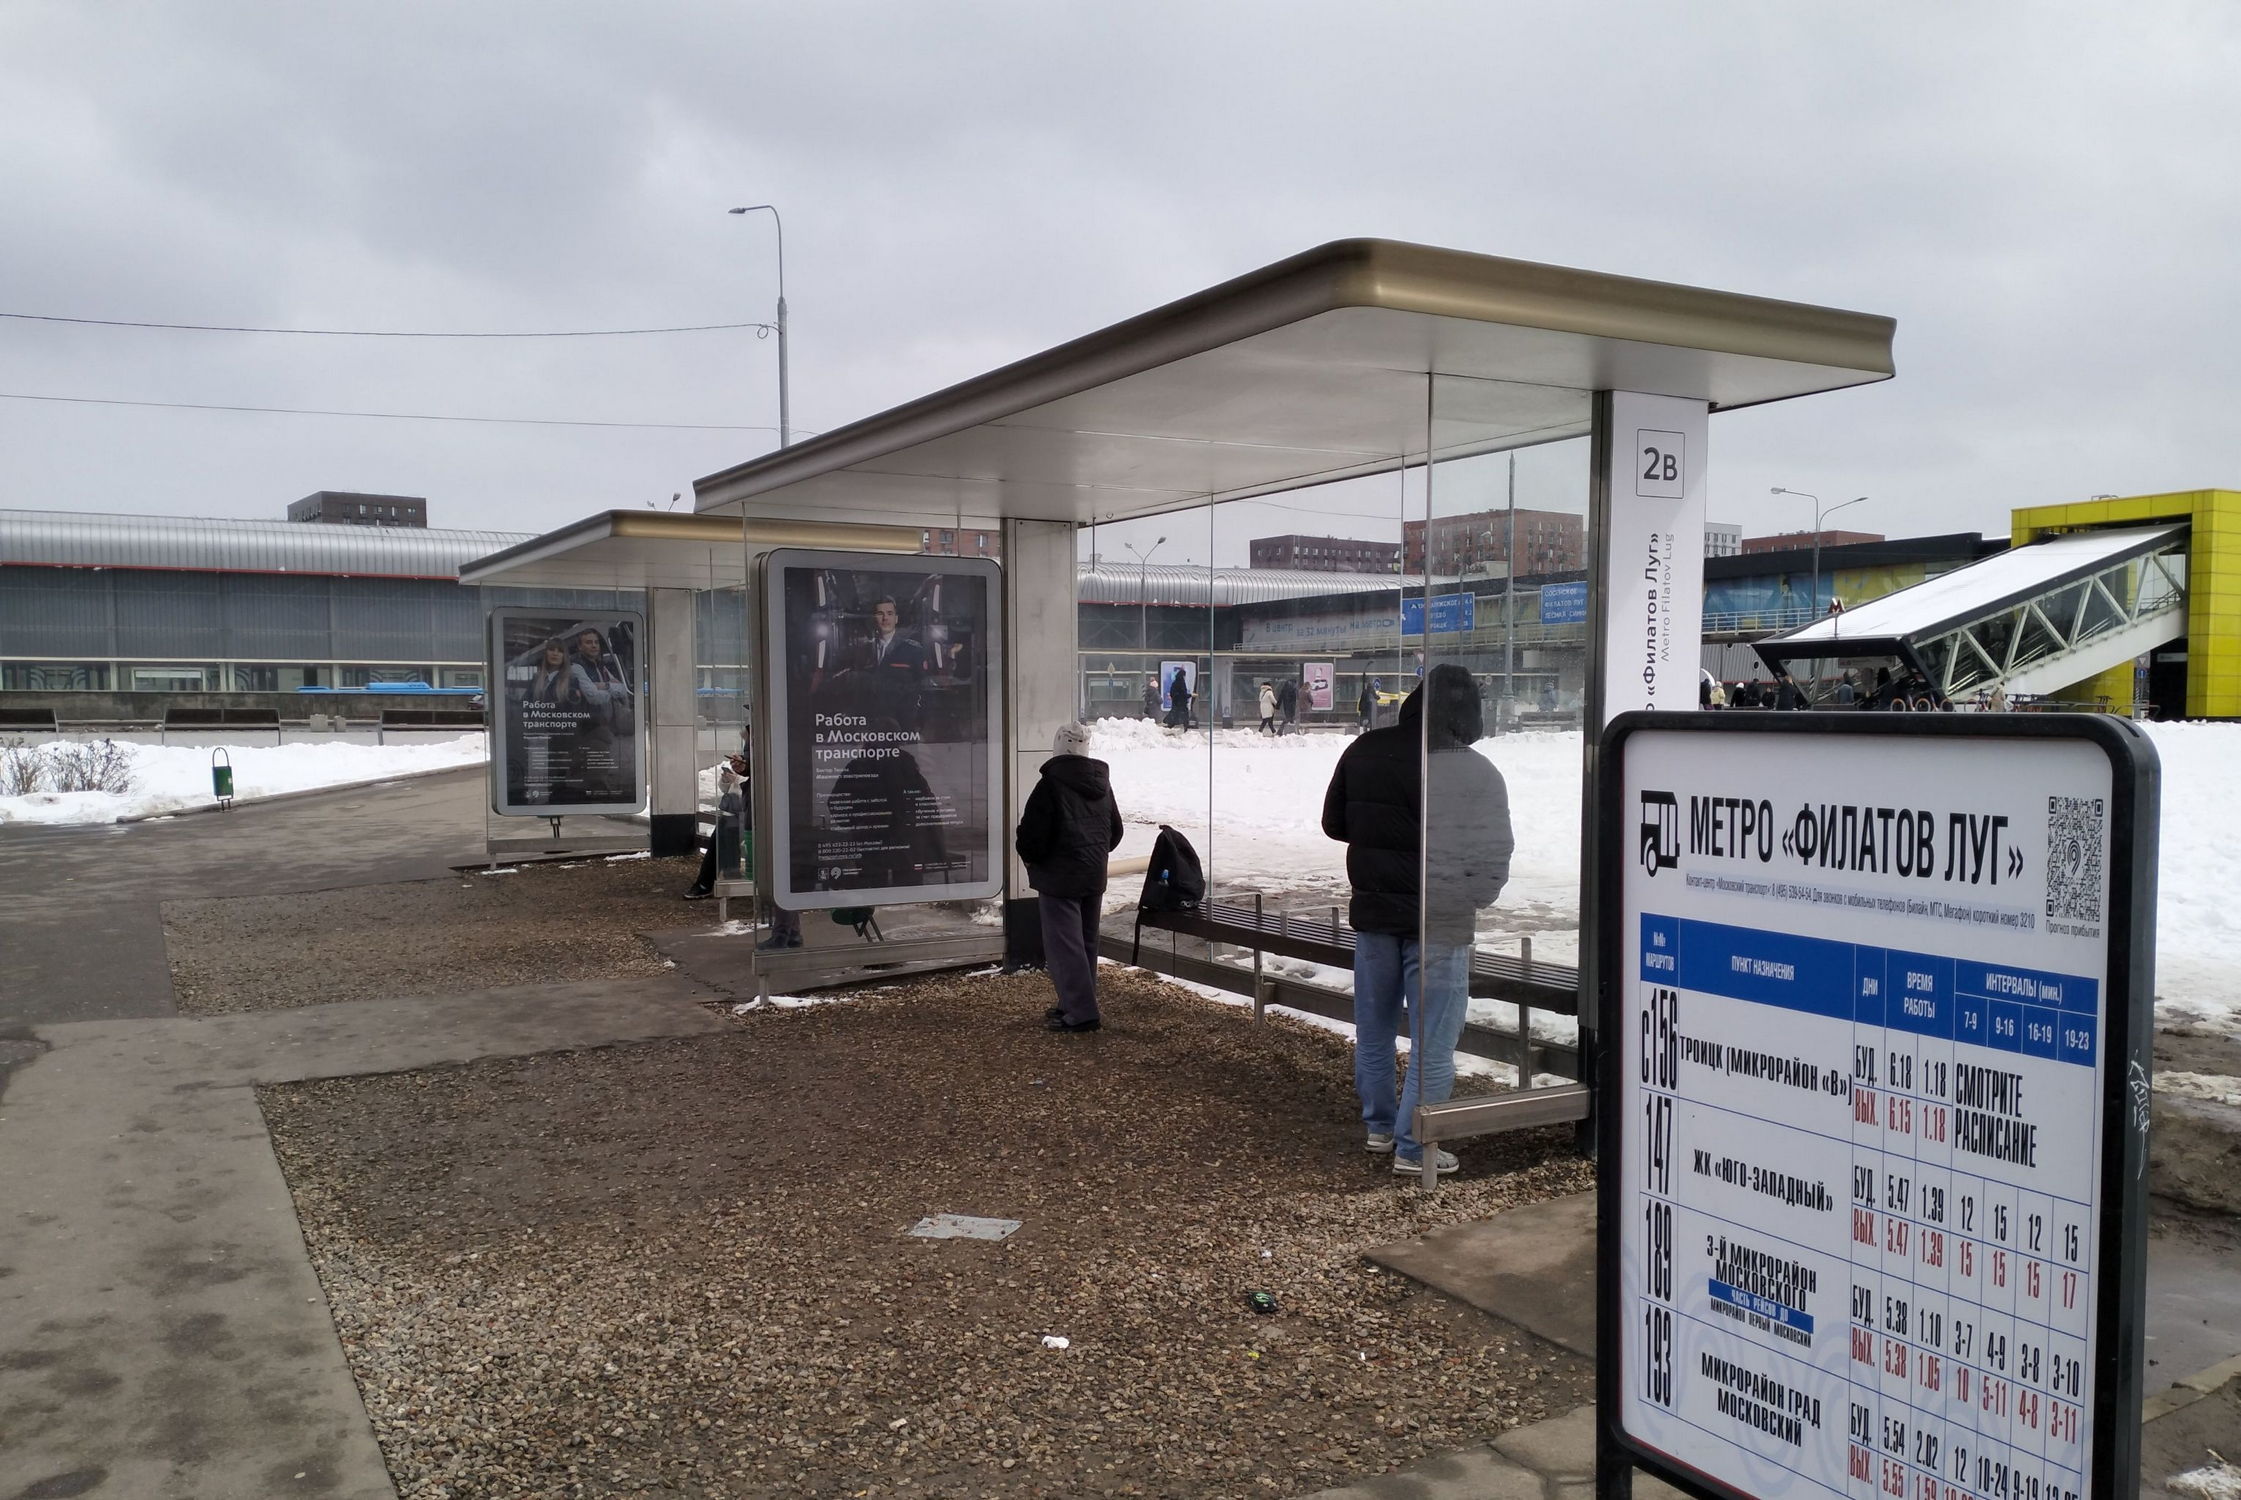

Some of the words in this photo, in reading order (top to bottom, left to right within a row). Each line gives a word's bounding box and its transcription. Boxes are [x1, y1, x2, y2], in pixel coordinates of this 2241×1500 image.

[1645, 532, 1661, 587] Луг»
[1662, 533, 1674, 560] Lug
[1661, 563, 1672, 613] Filatov
[1266, 623, 1270, 633] В
[1272, 623, 1293, 635] центр
[1316, 626, 1347, 638] минуты
[1642, 588, 1658, 697] «Филатов
[1661, 616, 1672, 662] Metro
[522, 700, 556, 709] Работа
[531, 710, 591, 719] Московском
[815, 713, 867, 726] Работа
[523, 720, 577, 729] транспорте
[816, 733, 824, 743] в
[827, 730, 921, 743] Московском
[815, 747, 900, 762] транспорте
[1690, 795, 1774, 863] МЕТРО
[1782, 803, 1935, 878] «ФИЛАТОВ
[1944, 812, 2024, 886] ЛУГ»
[1944, 903, 1971, 925] Мегафон)
[1973, 909, 1999, 925] короткий
[2001, 912, 2019, 930] номер
[2020, 912, 2036, 929] 3210
[2046, 920, 2070, 936] Прогноз
[2071, 925, 2100, 939] прибытия
[1645, 952, 1675, 971] МАРШРУТОВ
[1731, 955, 1752, 974] ПУНКТ
[1753, 959, 1795, 981] НАЗНАЧЕНИЯ
[1862, 977, 1878, 996] ДНИ
[1907, 971, 1933, 993] ВРЕМЯ
[1986, 973, 2037, 998] ИНТЕРВАЛЫ
[2039, 981, 2063, 1005] (мин.)
[1904, 997, 1935, 1018] РАБОТЫ
[1964, 1011, 1978, 1029] 7-9
[1995, 1016, 2014, 1037] 9-16
[2028, 1023, 2052, 1044] 16-19
[2065, 1029, 2090, 1051] 19-23
[1680, 1036, 1723, 1071] ТРОИЦК
[1726, 1046, 1818, 1092] (МИКРОРАЙОН
[1856, 1045, 1878, 1088] БУД.
[1890, 1052, 1912, 1090] 6.18
[1924, 1059, 1946, 1098] 1.18
[1855, 1088, 1879, 1127] ВЫХ.
[1956, 1062, 2023, 1118] СМОТРИТЕ
[1889, 1096, 1911, 1134] 6.15
[1924, 1104, 1945, 1143] 1.18
[1646, 1093, 1672, 1195] 147
[1955, 1108, 2037, 1168] РАСПИСАНИЕ
[1693, 1149, 1711, 1177] ЖК
[1715, 1157, 1833, 1212] «ЮГО-ЗАПАДНЫЙ»
[1854, 1165, 1876, 1209] БУД.
[1888, 1174, 1909, 1213] 5.47
[1922, 1184, 1944, 1223] 1.39
[1961, 1195, 1973, 1232] 12
[1994, 1204, 2007, 1242] 15
[1853, 1208, 1877, 1247] ВЫХ.
[1887, 1218, 1909, 1257] 5.47
[2029, 1213, 2042, 1252] 12
[2065, 1223, 2079, 1262] 15
[1646, 1199, 1672, 1302] 189
[1706, 1235, 1727, 1261] 3-Й
[1730, 1243, 1817, 1294] МИКРОРАЙОН
[1921, 1228, 1943, 1268] 1.39
[1960, 1240, 1972, 1277] 15
[1716, 1259, 1806, 1312] МОСКОВСКОГО
[1993, 1250, 2006, 1288] 15
[2027, 1261, 2040, 1299] 15
[1732, 1289, 1750, 1307] ЧАСТЬ
[1753, 1297, 1776, 1318] РЕЙСОВ
[1780, 1307, 1789, 1322] ДО
[1853, 1285, 1874, 1329] БУД.
[2063, 1271, 2076, 1310] 17
[1711, 1297, 1745, 1323] МИКРОРАЙОН
[1749, 1312, 1770, 1333] ПЕРВЫЙ
[1774, 1321, 1811, 1348] МОСКОВСКИЙ
[1886, 1296, 1908, 1335] 5.38
[1920, 1308, 1941, 1348] 1.10
[1646, 1304, 1671, 1407] 193
[1852, 1327, 1875, 1367] ВЫХ.
[1955, 1320, 1972, 1358] 3-7
[1987, 1332, 2005, 1370] 4-9
[1885, 1340, 1907, 1378] 5.38
[1919, 1352, 1940, 1391] 1.05
[2021, 1344, 2039, 1383] 3-8
[2053, 1354, 2079, 1397] 3-10
[1702, 1352, 1784, 1411] МИКРОРАЙОН
[1788, 1389, 1821, 1429] ГРАД
[1957, 1366, 1969, 1403] 10
[1983, 1376, 2007, 1417] 5-11
[1717, 1388, 1802, 1447] МОСКОВСКИЙ
[1850, 1402, 1872, 1446] БУД.
[2019, 1389, 2038, 1429] 4-8
[2051, 1401, 2076, 1444] 3-11
[1884, 1416, 1905, 1457] 5.54
[1917, 1430, 1938, 1470] 2.02
[1850, 1443, 1873, 1485] ВЫХ.
[1883, 1458, 1904, 1498] 5.55
[1955, 1446, 1966, 1483] 12
[1978, 1455, 2008, 1500] 10-24
